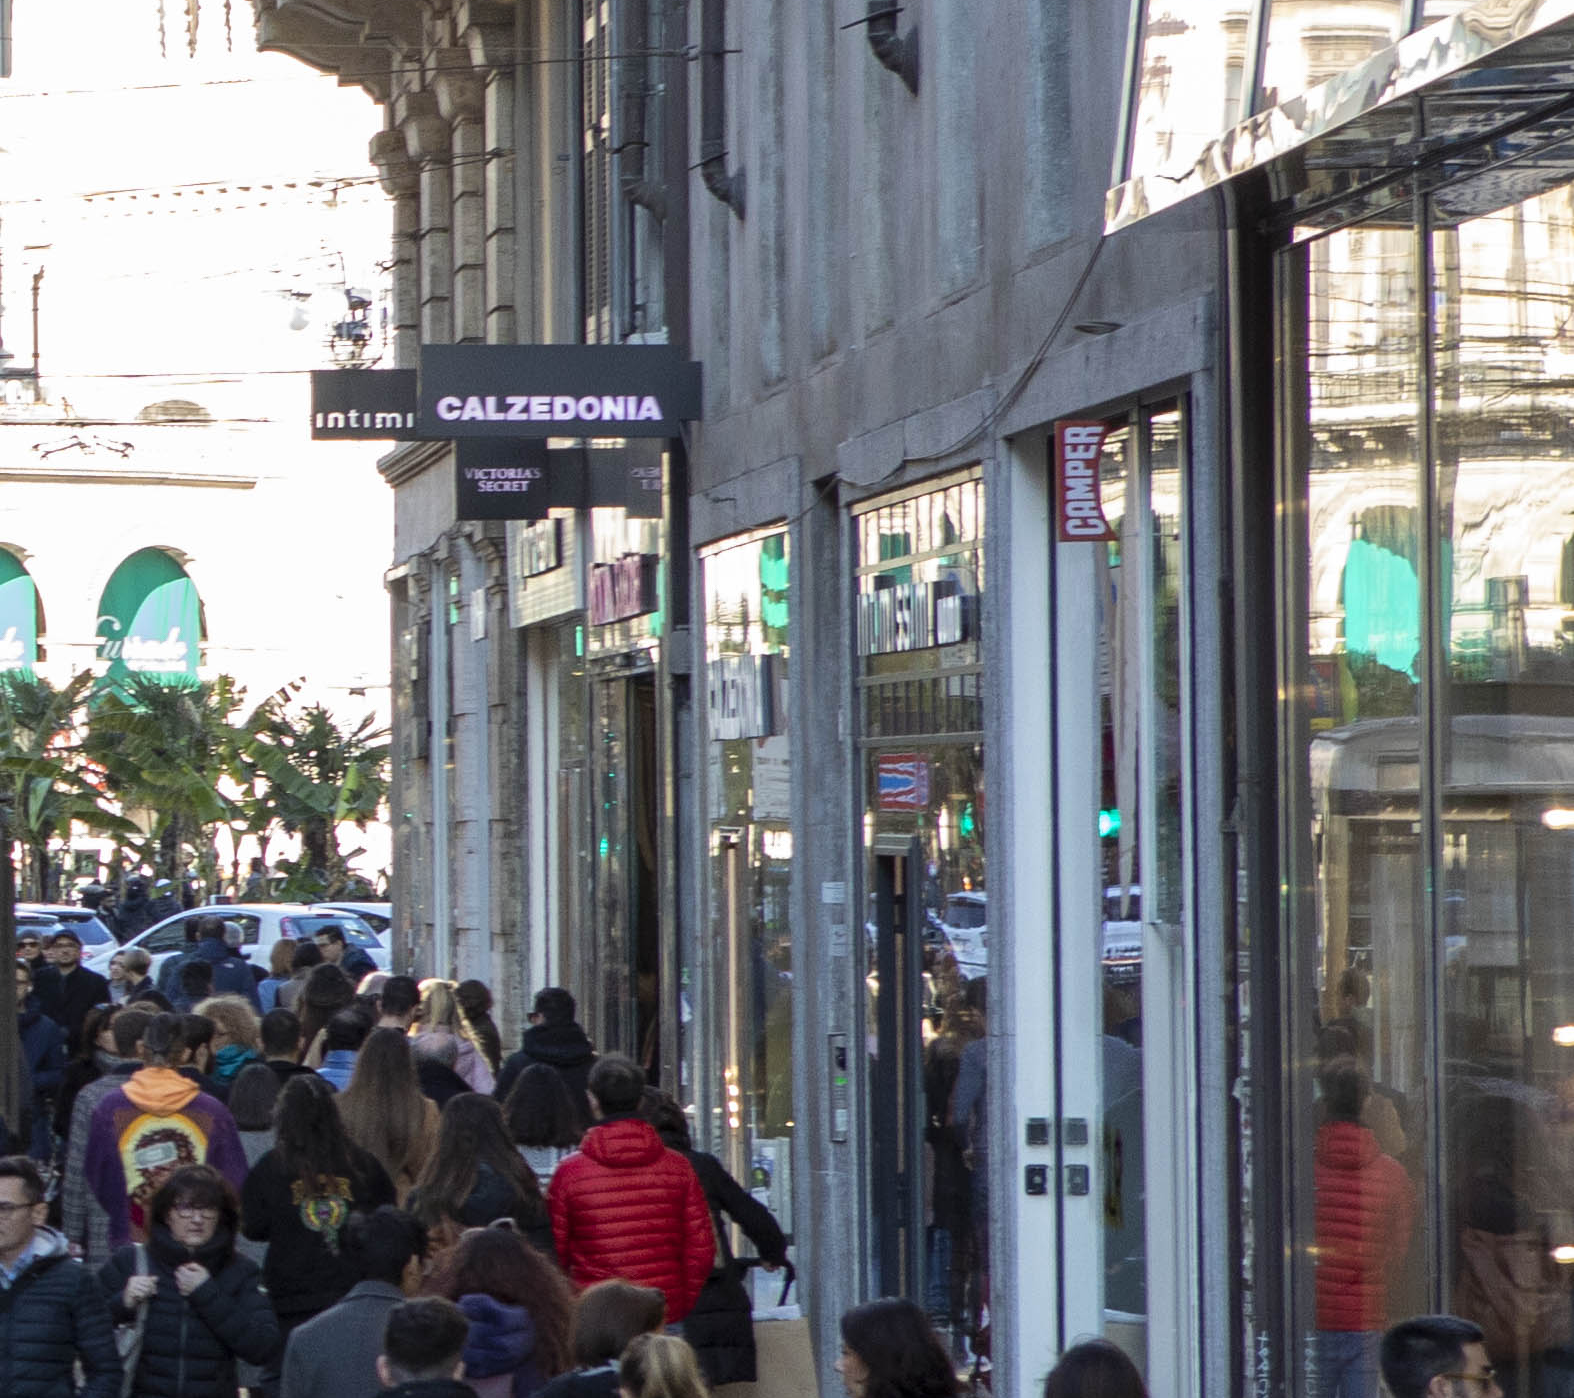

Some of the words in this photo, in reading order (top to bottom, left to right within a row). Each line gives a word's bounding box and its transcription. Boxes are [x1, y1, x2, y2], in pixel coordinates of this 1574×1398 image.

[437, 396, 663, 421] CALZEDONIA
[477, 480, 530, 492] SECRET
[1064, 426, 1105, 536] CAMPER
